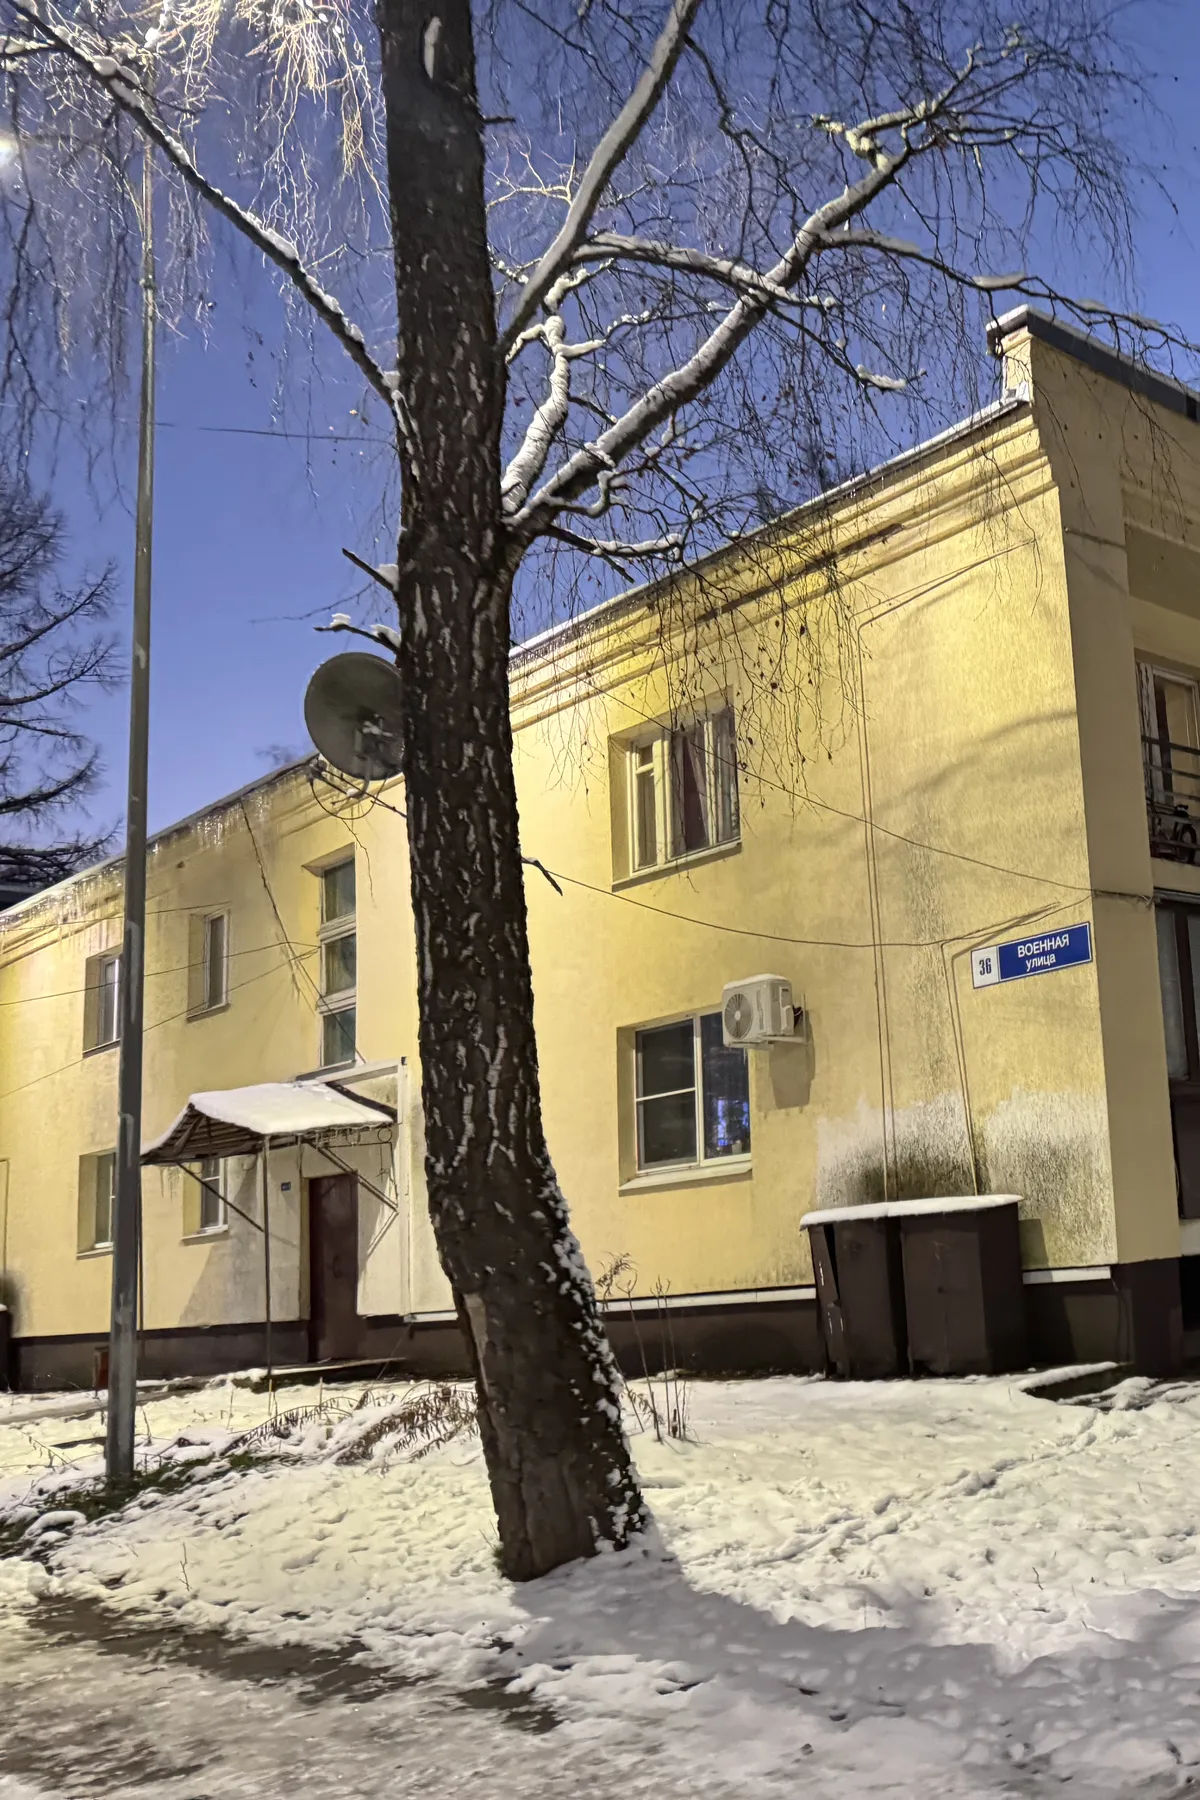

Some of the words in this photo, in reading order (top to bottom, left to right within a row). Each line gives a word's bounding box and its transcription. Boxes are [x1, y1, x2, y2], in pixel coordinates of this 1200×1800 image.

[1017, 933, 1070, 958] ВОЕННАЯ
[978, 957, 992, 976] 36
[1025, 952, 1057, 972] улица
